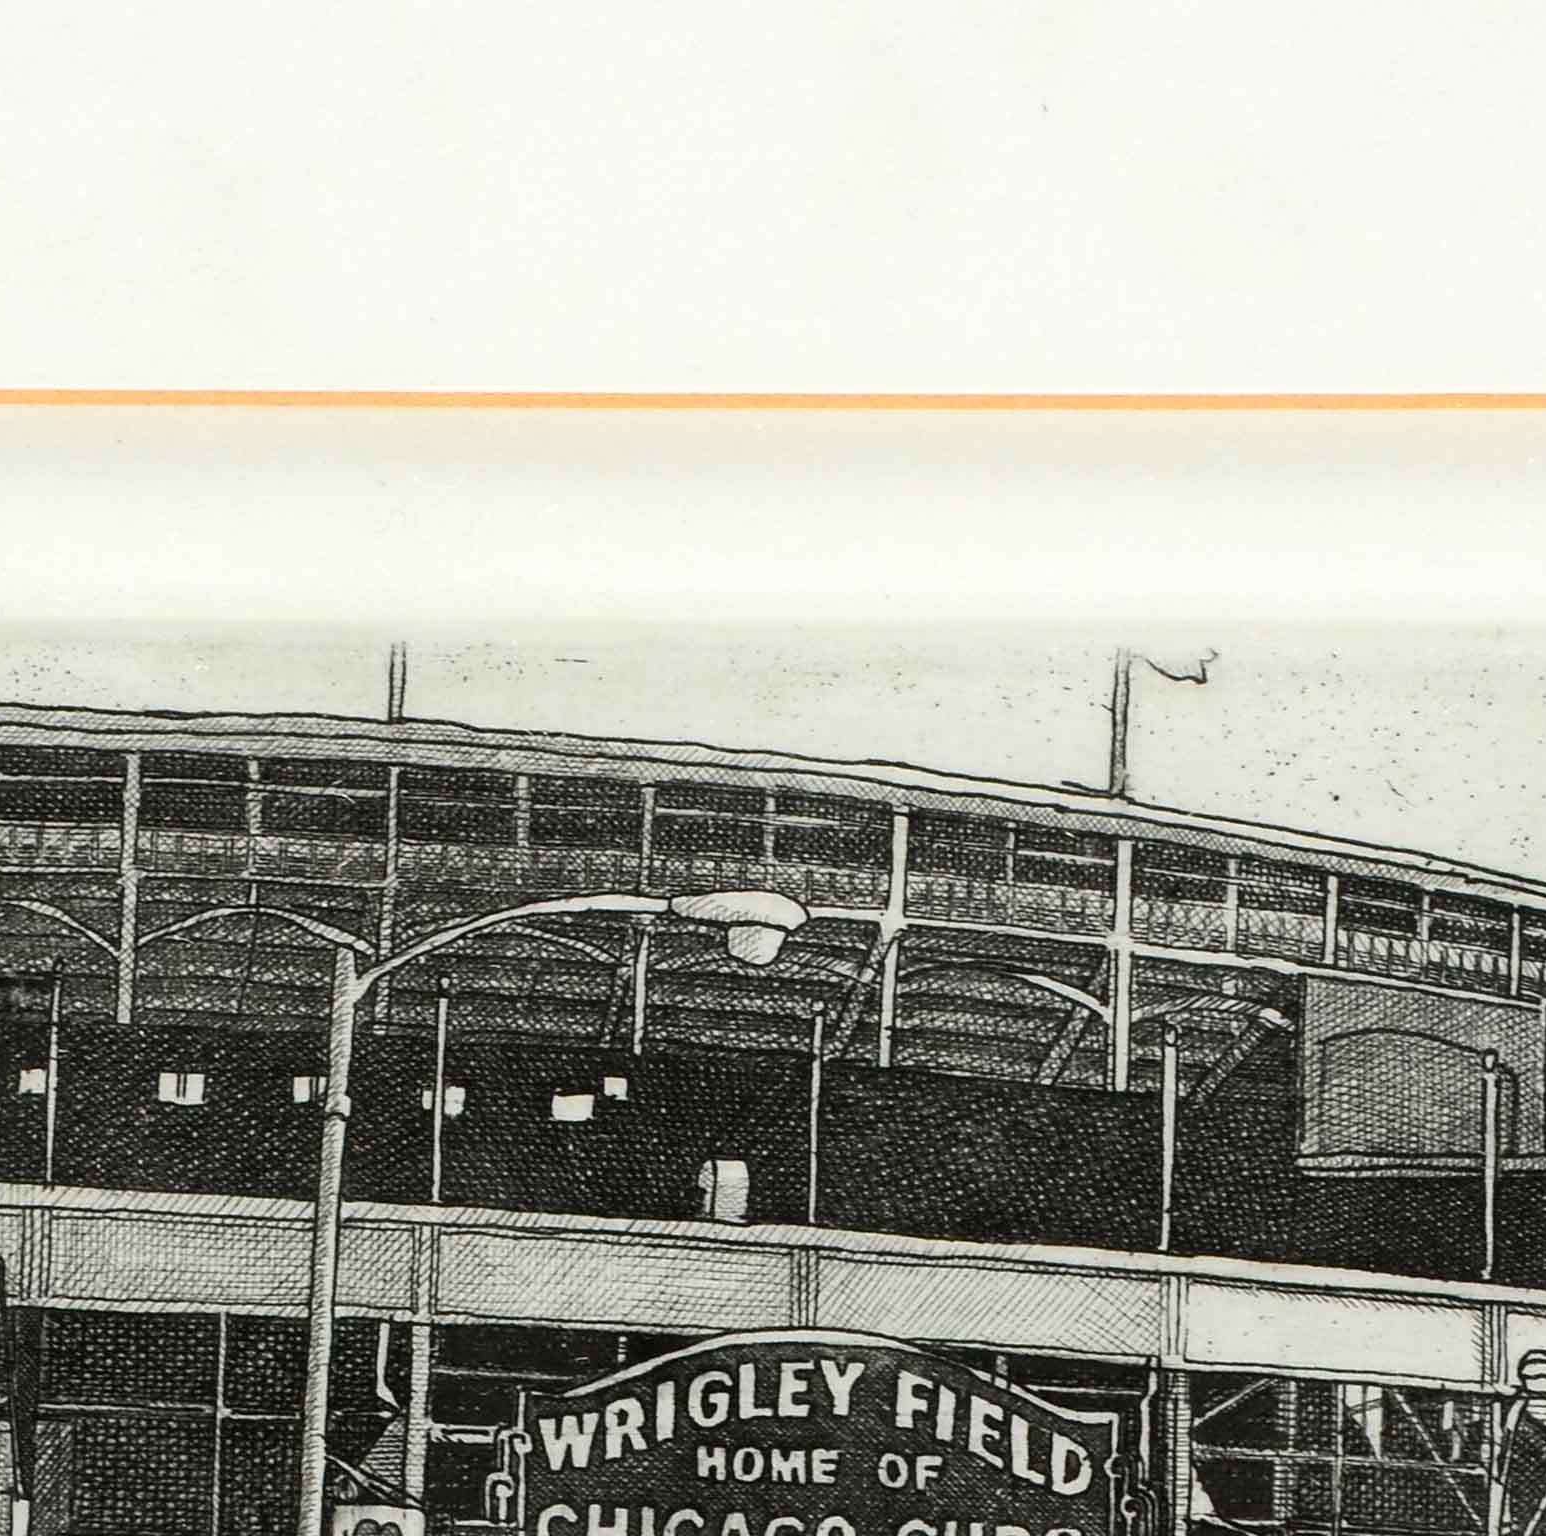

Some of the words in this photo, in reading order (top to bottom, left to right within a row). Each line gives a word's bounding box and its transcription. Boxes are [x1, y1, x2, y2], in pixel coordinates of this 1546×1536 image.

[538, 1359, 865, 1471] WRIGLEY
[895, 1369, 1092, 1496] FIELD
[697, 1446, 839, 1484] HOME
[877, 1452, 943, 1491] OF
